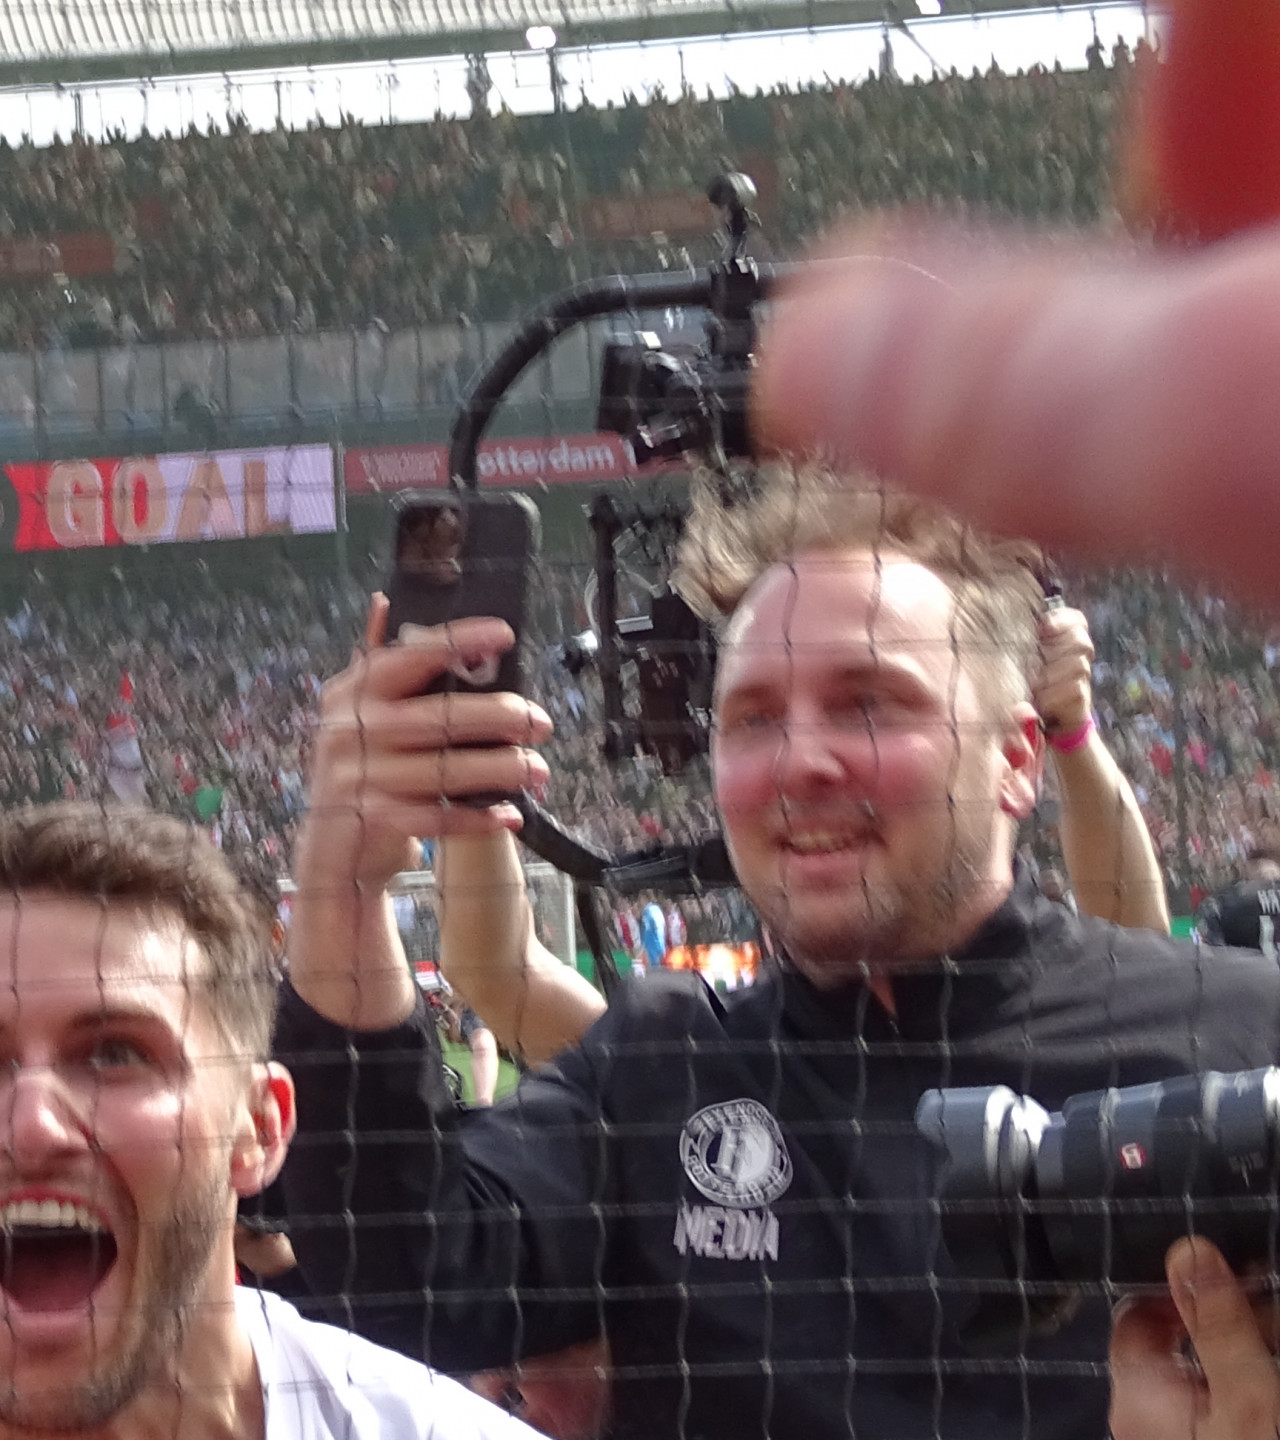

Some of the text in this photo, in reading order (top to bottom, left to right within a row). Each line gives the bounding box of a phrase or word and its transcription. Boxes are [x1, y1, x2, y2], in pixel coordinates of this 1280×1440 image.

[476, 440, 616, 478] otterdam
[46, 452, 292, 548] GOAL
[673, 1196, 780, 1262] MEDIA
